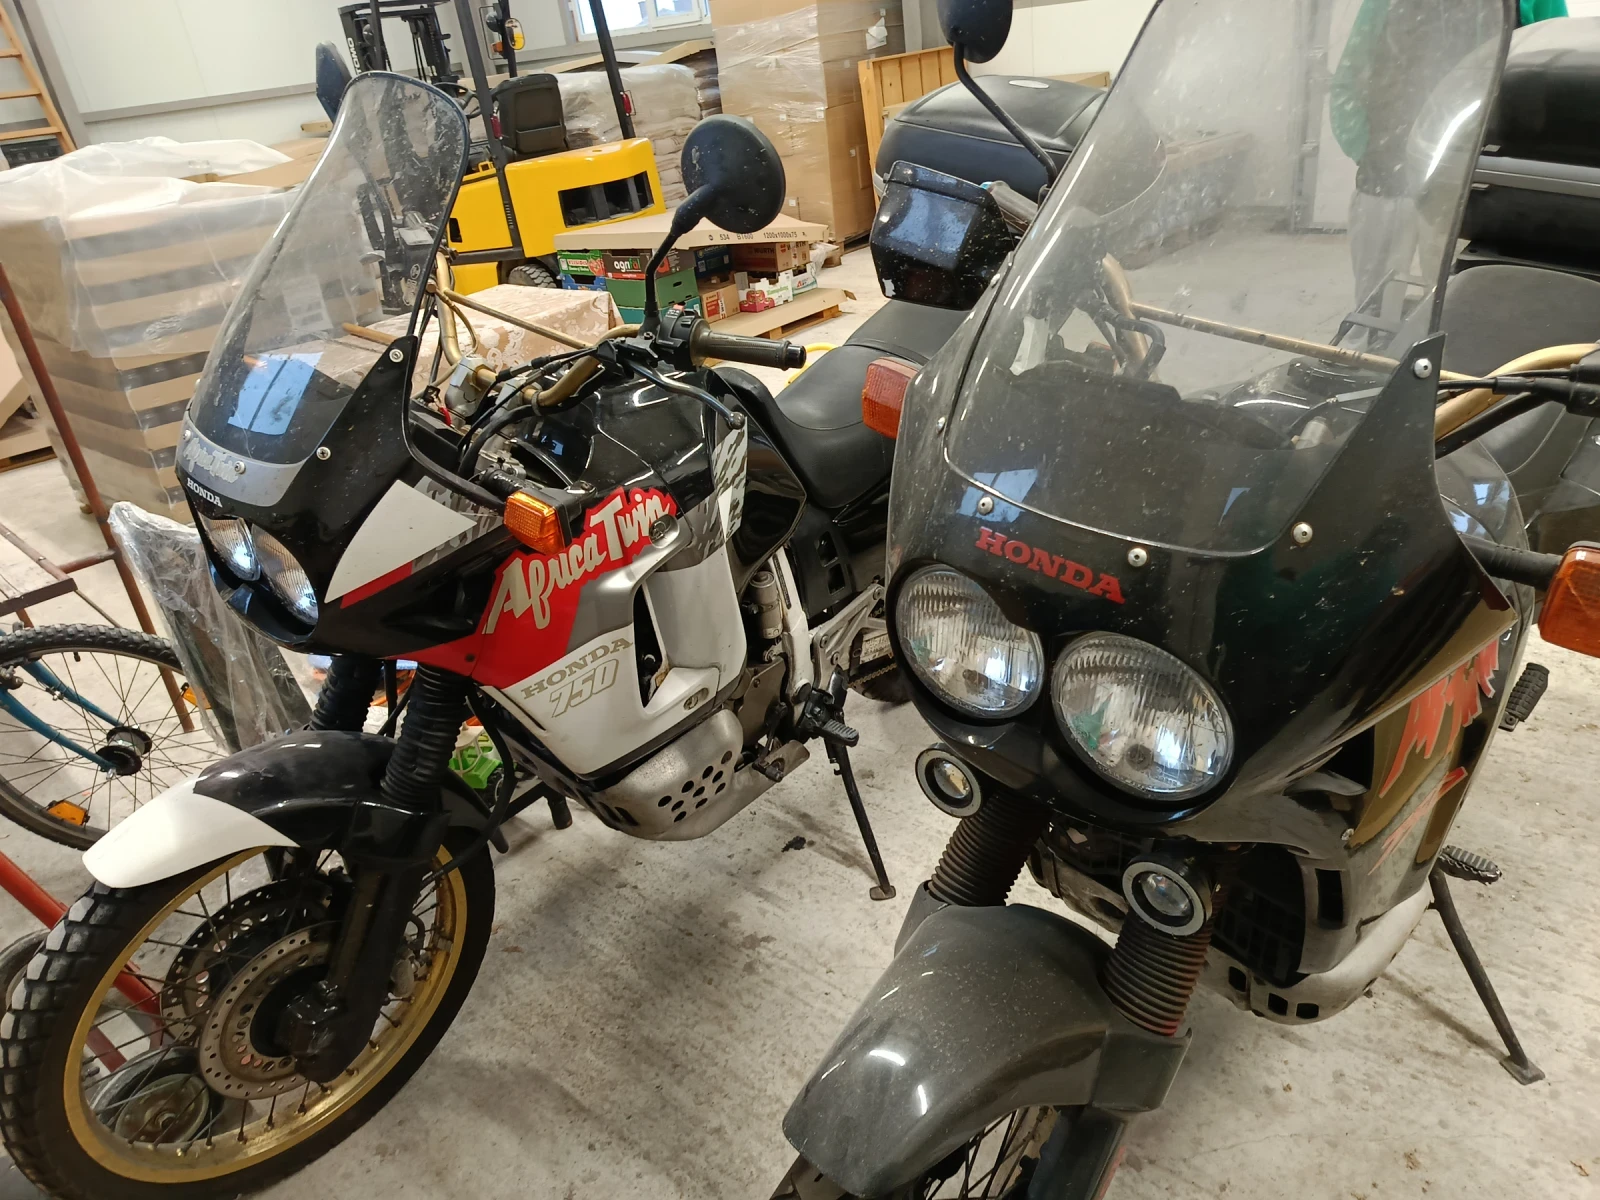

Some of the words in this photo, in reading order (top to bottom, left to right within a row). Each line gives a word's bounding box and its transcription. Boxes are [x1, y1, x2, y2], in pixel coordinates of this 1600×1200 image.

[187, 477, 223, 508] HONDA
[482, 531, 608, 634] Africa
[590, 494, 671, 562] Twin
[974, 526, 1126, 605] HONDA
[521, 637, 634, 700] HONDA
[549, 657, 620, 719] 750
